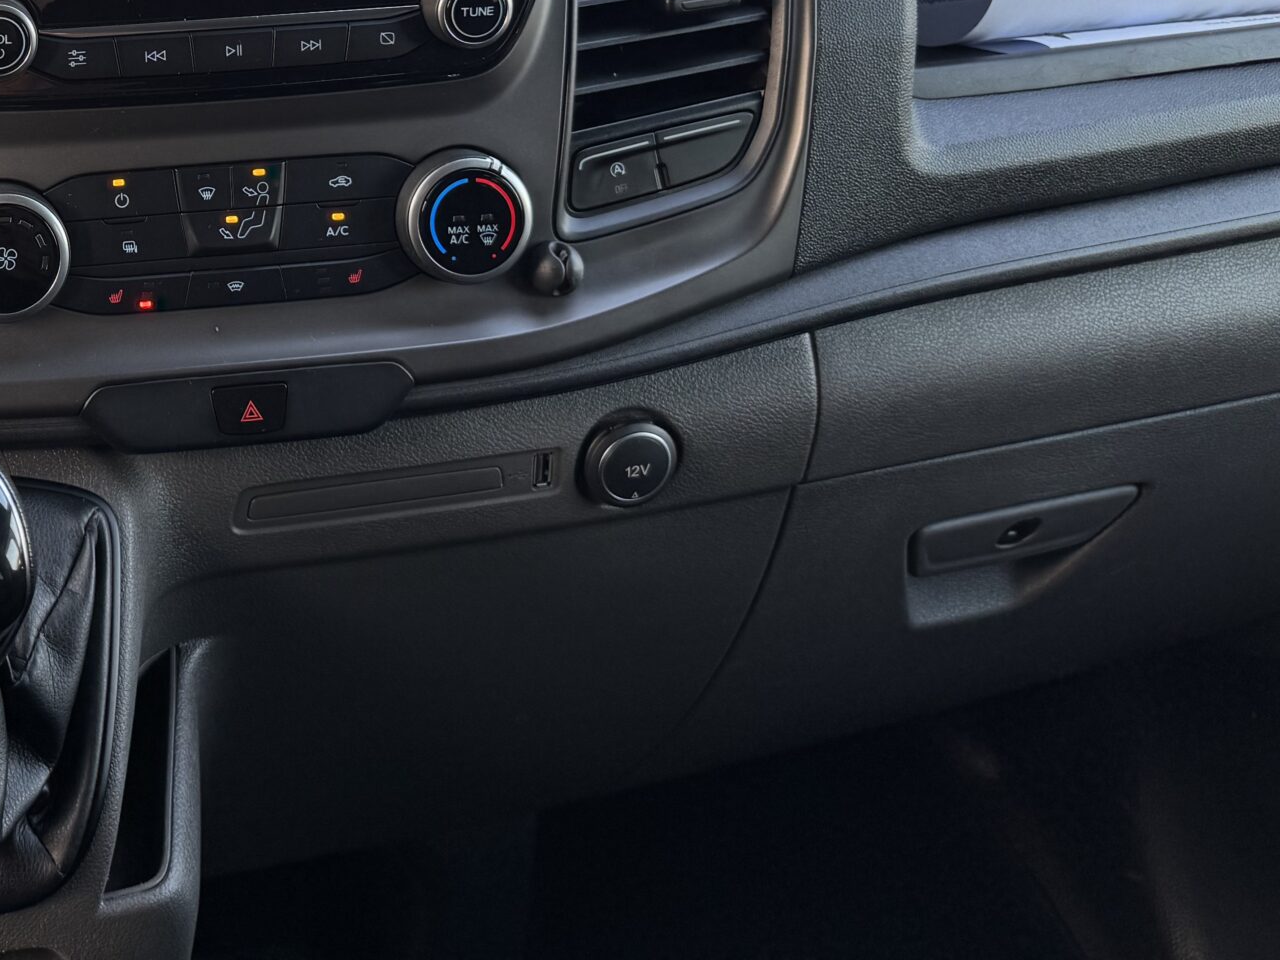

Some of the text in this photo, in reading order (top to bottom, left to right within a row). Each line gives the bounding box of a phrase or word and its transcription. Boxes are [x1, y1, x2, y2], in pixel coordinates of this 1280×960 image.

[461, 5, 494, 19] TUNE
[326, 225, 350, 237] A/C
[447, 226, 470, 235] MAX
[477, 224, 499, 233] MAX
[450, 234, 469, 245] A/C
[624, 463, 651, 478] 12V
